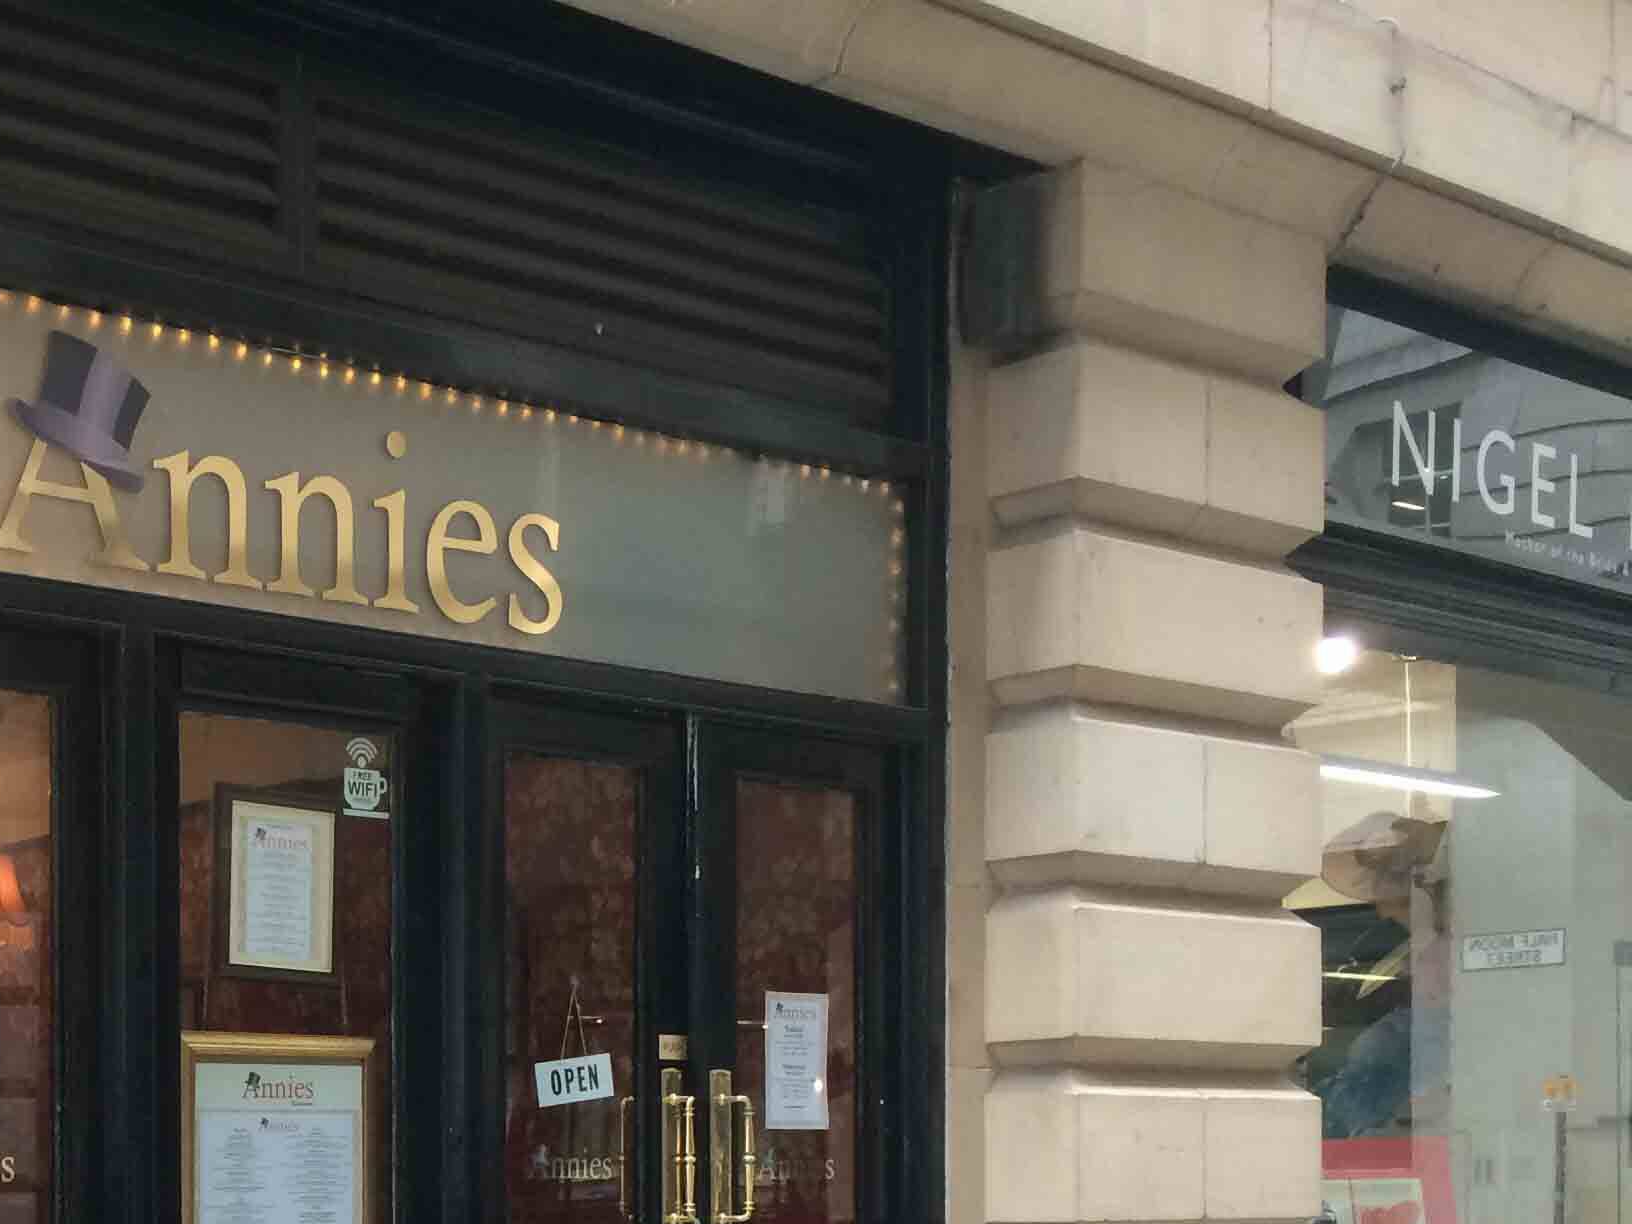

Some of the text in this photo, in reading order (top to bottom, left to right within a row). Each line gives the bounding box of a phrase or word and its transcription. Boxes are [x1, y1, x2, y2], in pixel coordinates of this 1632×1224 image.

[1391, 400, 1594, 539] NIGEL
[348, 780, 378, 798] WIFI
[550, 1063, 600, 1096] OPEN
